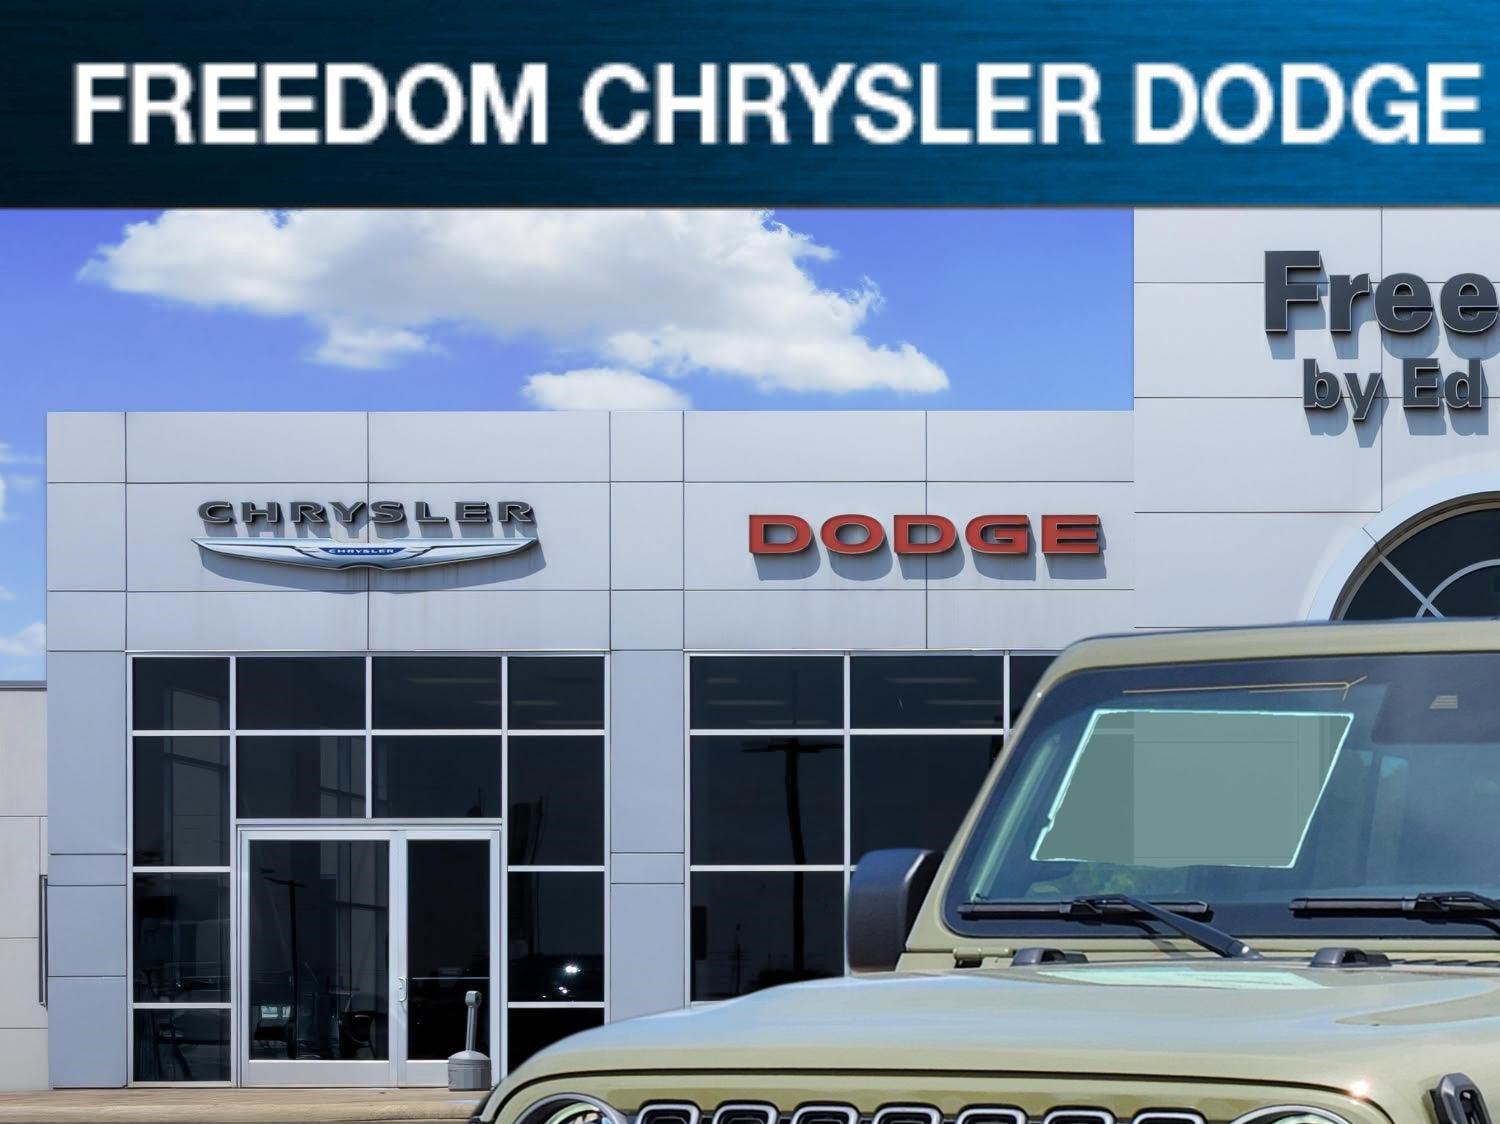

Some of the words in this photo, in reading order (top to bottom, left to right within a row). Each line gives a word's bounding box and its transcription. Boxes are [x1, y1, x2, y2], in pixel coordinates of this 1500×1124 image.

[1303, 358, 1382, 421] by
[1402, 358, 1482, 409] Ed
[197, 501, 534, 524] CHRYSLER
[749, 514, 1100, 554] DODGE
